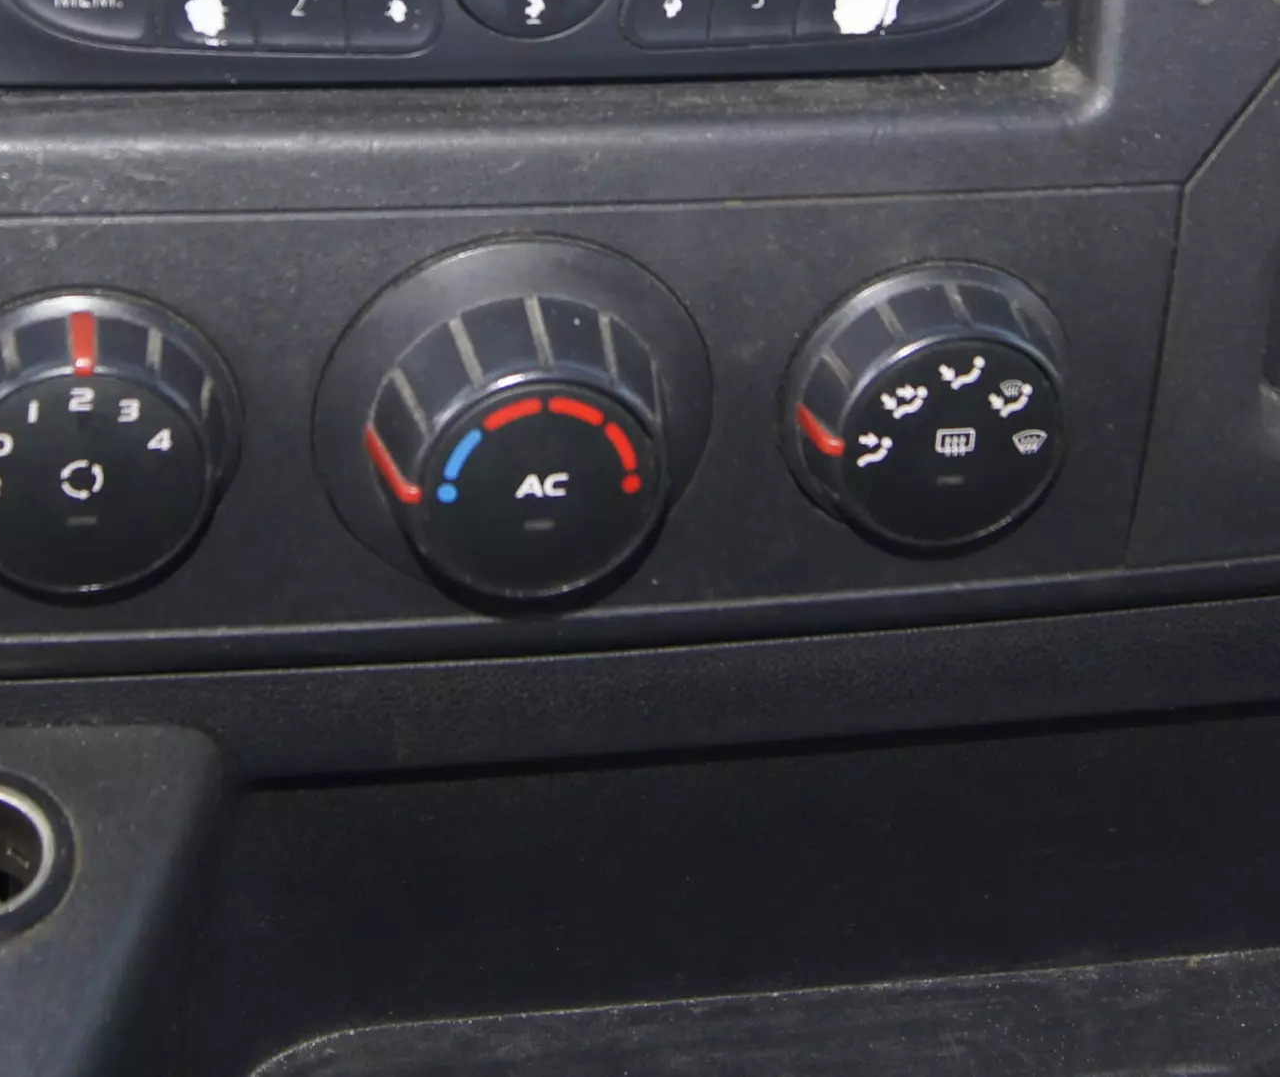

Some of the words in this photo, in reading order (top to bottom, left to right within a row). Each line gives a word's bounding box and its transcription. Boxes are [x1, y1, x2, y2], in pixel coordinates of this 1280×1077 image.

[27, 399, 40, 424] 1
[68, 387, 95, 413] 2
[117, 398, 141, 423] 3
[146, 427, 173, 452] 4
[515, 472, 569, 499] AC
